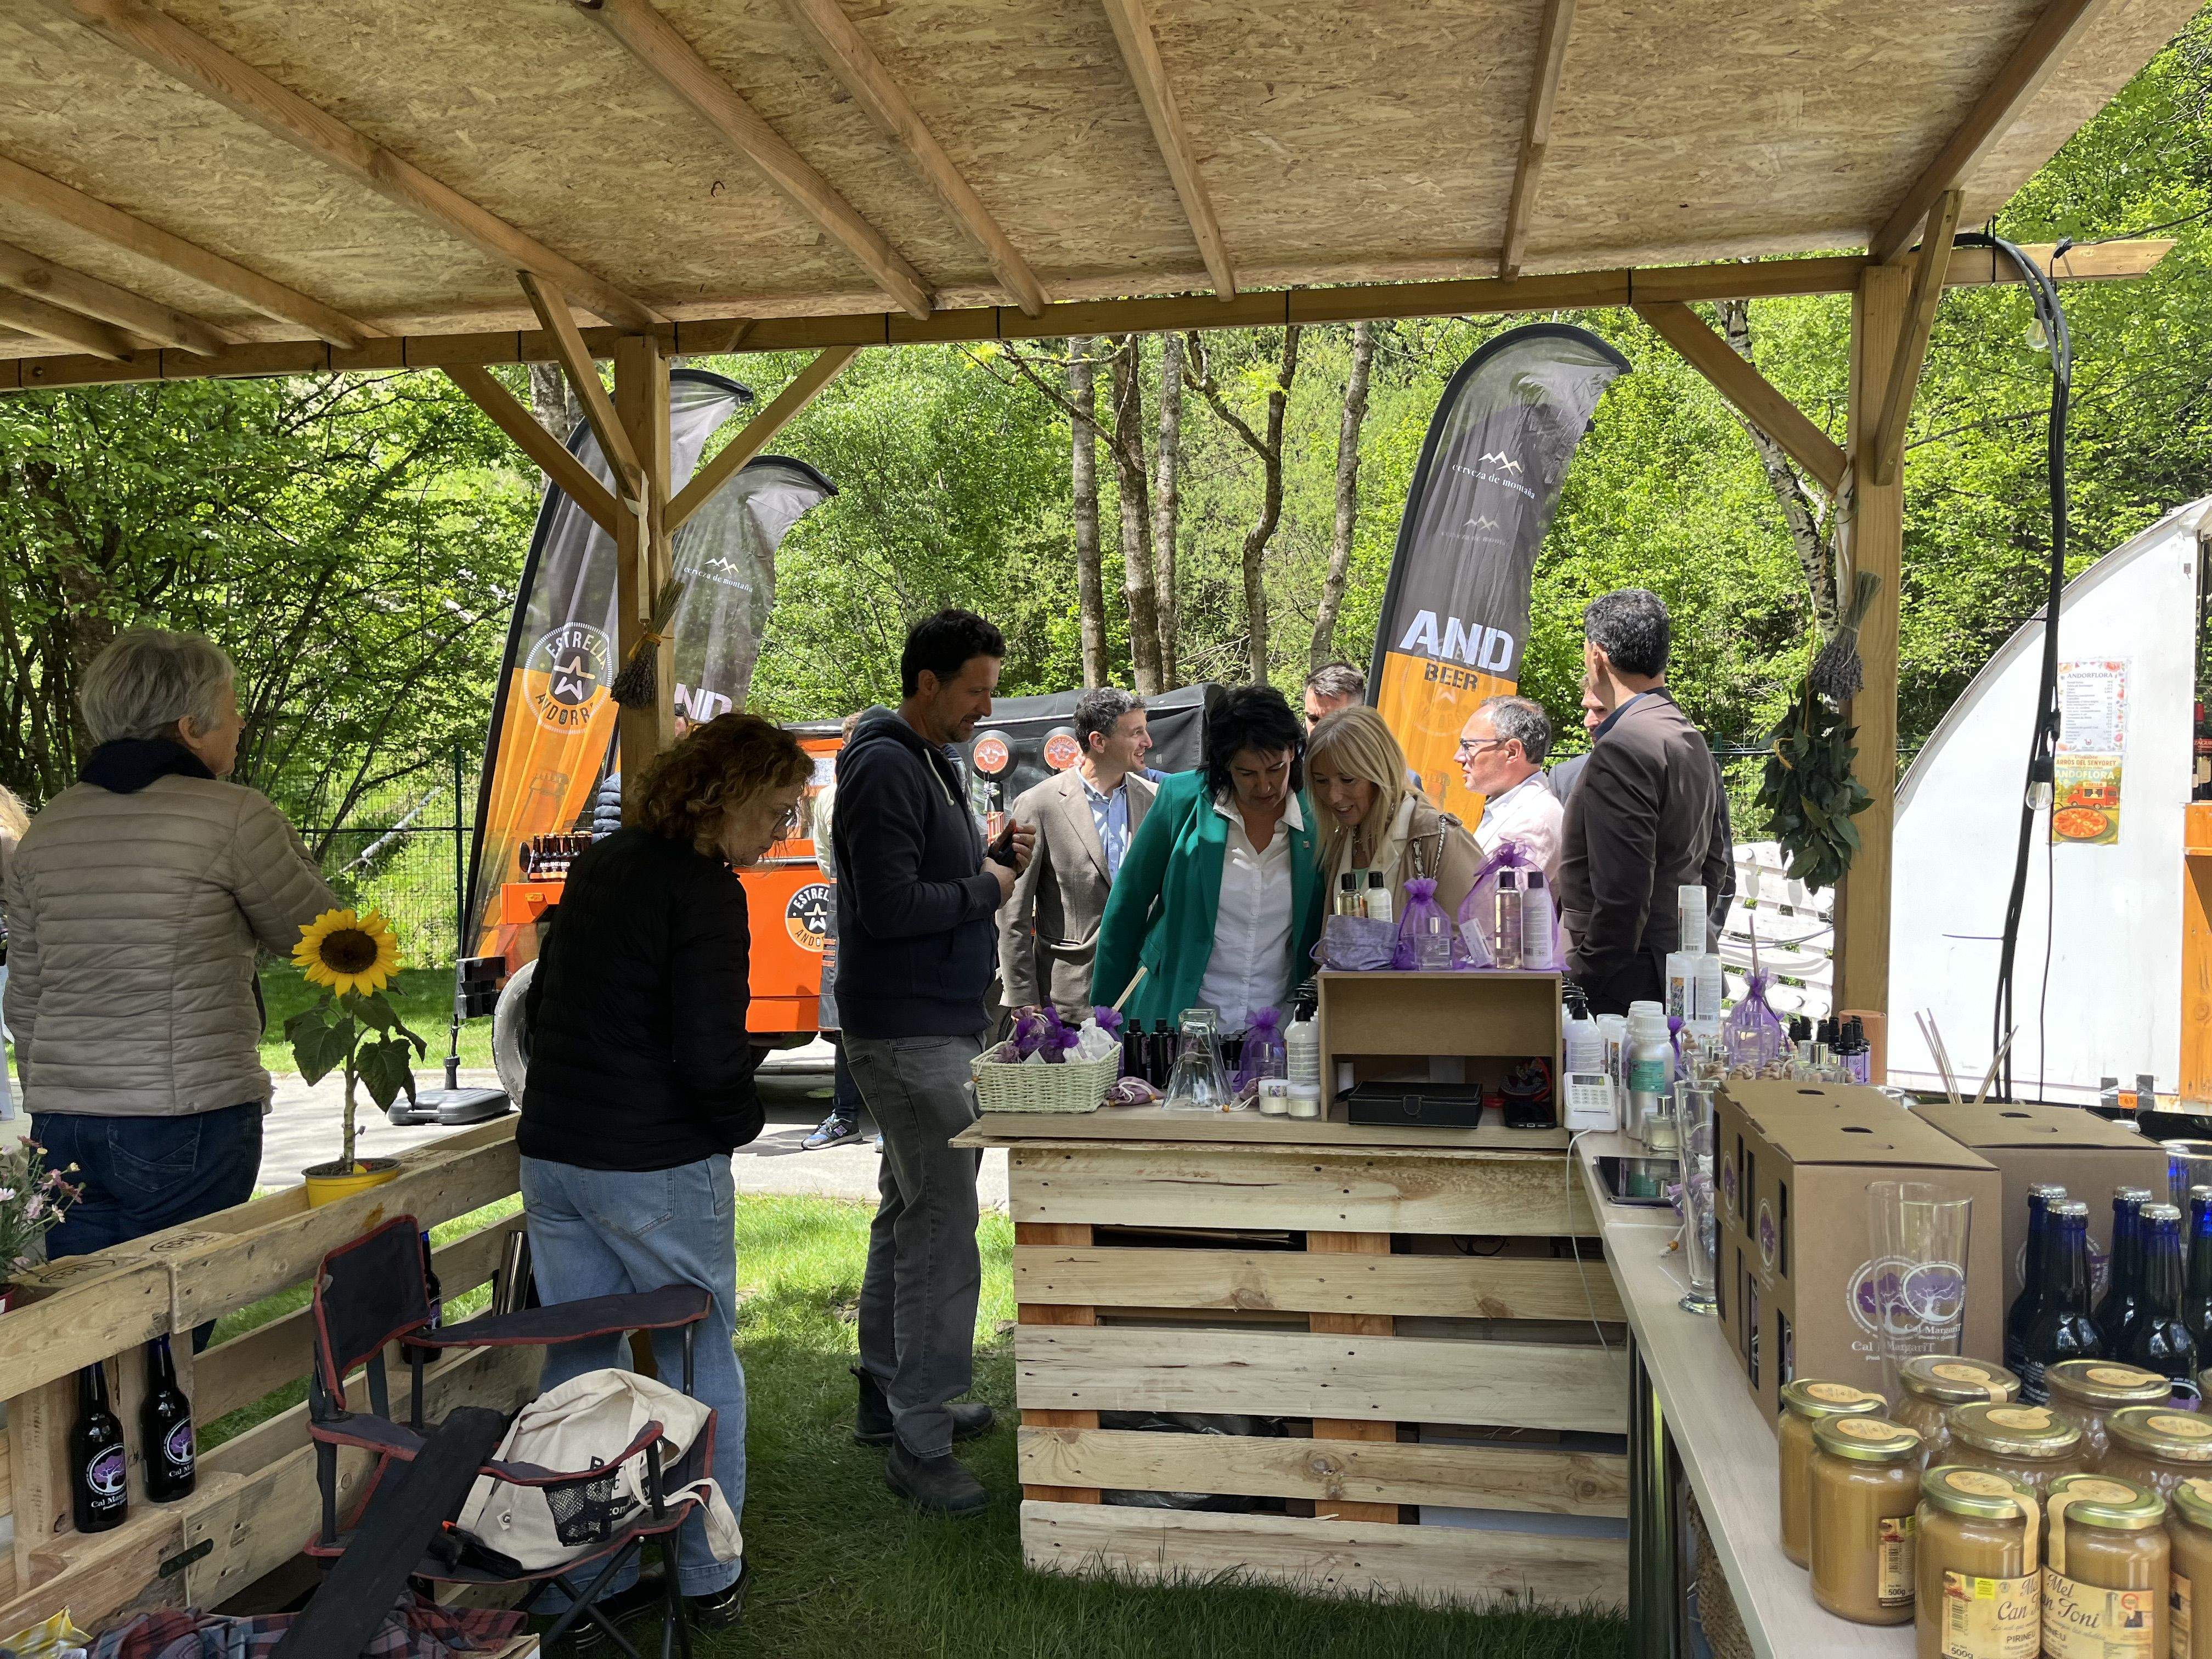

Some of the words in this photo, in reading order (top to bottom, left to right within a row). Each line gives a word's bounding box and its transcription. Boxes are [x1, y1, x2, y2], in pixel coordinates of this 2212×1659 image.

[1452, 464, 1486, 480] cerveza
[1488, 473, 1500, 484] de
[1502, 479, 1536, 500] montaña
[684, 566, 711, 580] cerveza
[713, 573, 723, 583] de
[723, 578, 754, 593] montaña
[1399, 609, 1514, 673] AND
[1424, 662, 1479, 692] BEER
[535, 692, 594, 726] ANDORR
[2056, 769, 2115, 780] ANDOFLORA
[793, 887, 830, 910] ESTREL
[1852, 1341, 1874, 1352] Cal
[2046, 1573, 2075, 1599] Mel
[1997, 1601, 2028, 1621] Can
[2057, 1597, 2101, 1629] Toni
[1951, 1646, 1973, 1659] 500g
